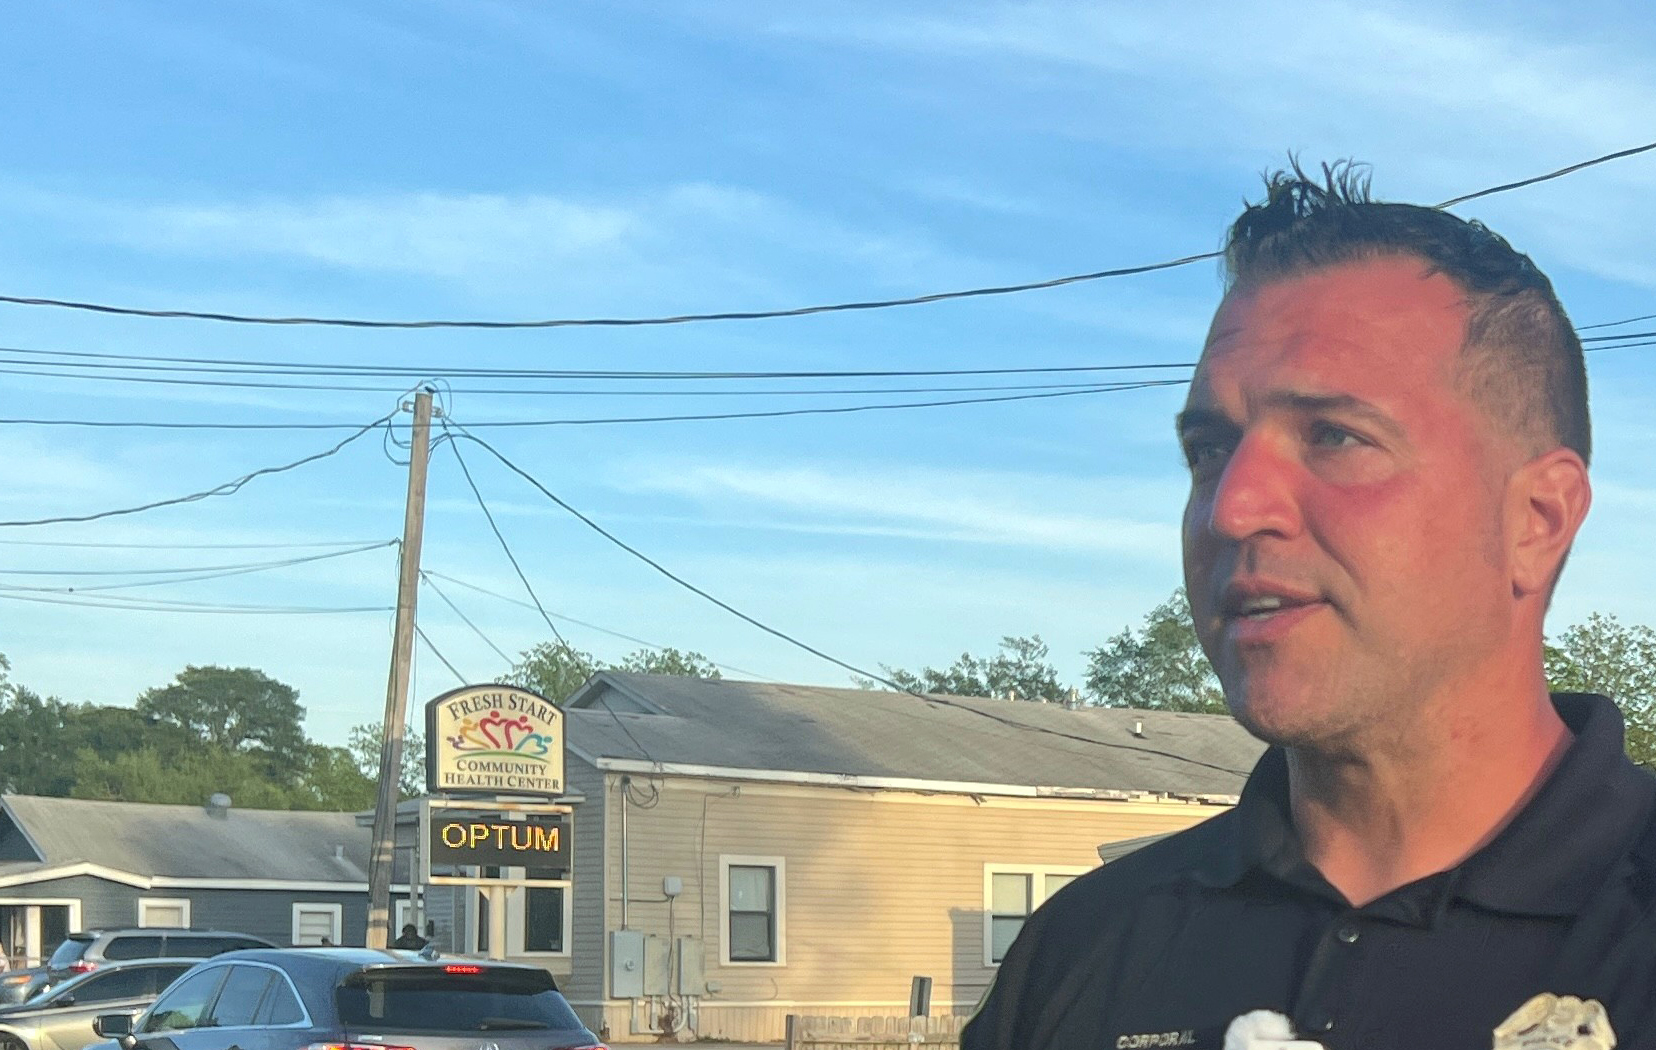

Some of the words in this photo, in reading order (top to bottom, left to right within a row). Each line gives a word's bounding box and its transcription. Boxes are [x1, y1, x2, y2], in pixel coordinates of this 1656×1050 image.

[446, 693, 503, 721] FRESH
[508, 692, 557, 726] START
[456, 759, 547, 776] COMMUNITY
[445, 772, 503, 787] HEALTH
[507, 775, 560, 790] CENTER
[442, 823, 559, 851] OPTUM
[1116, 1030, 1196, 1049] CORPORAL
